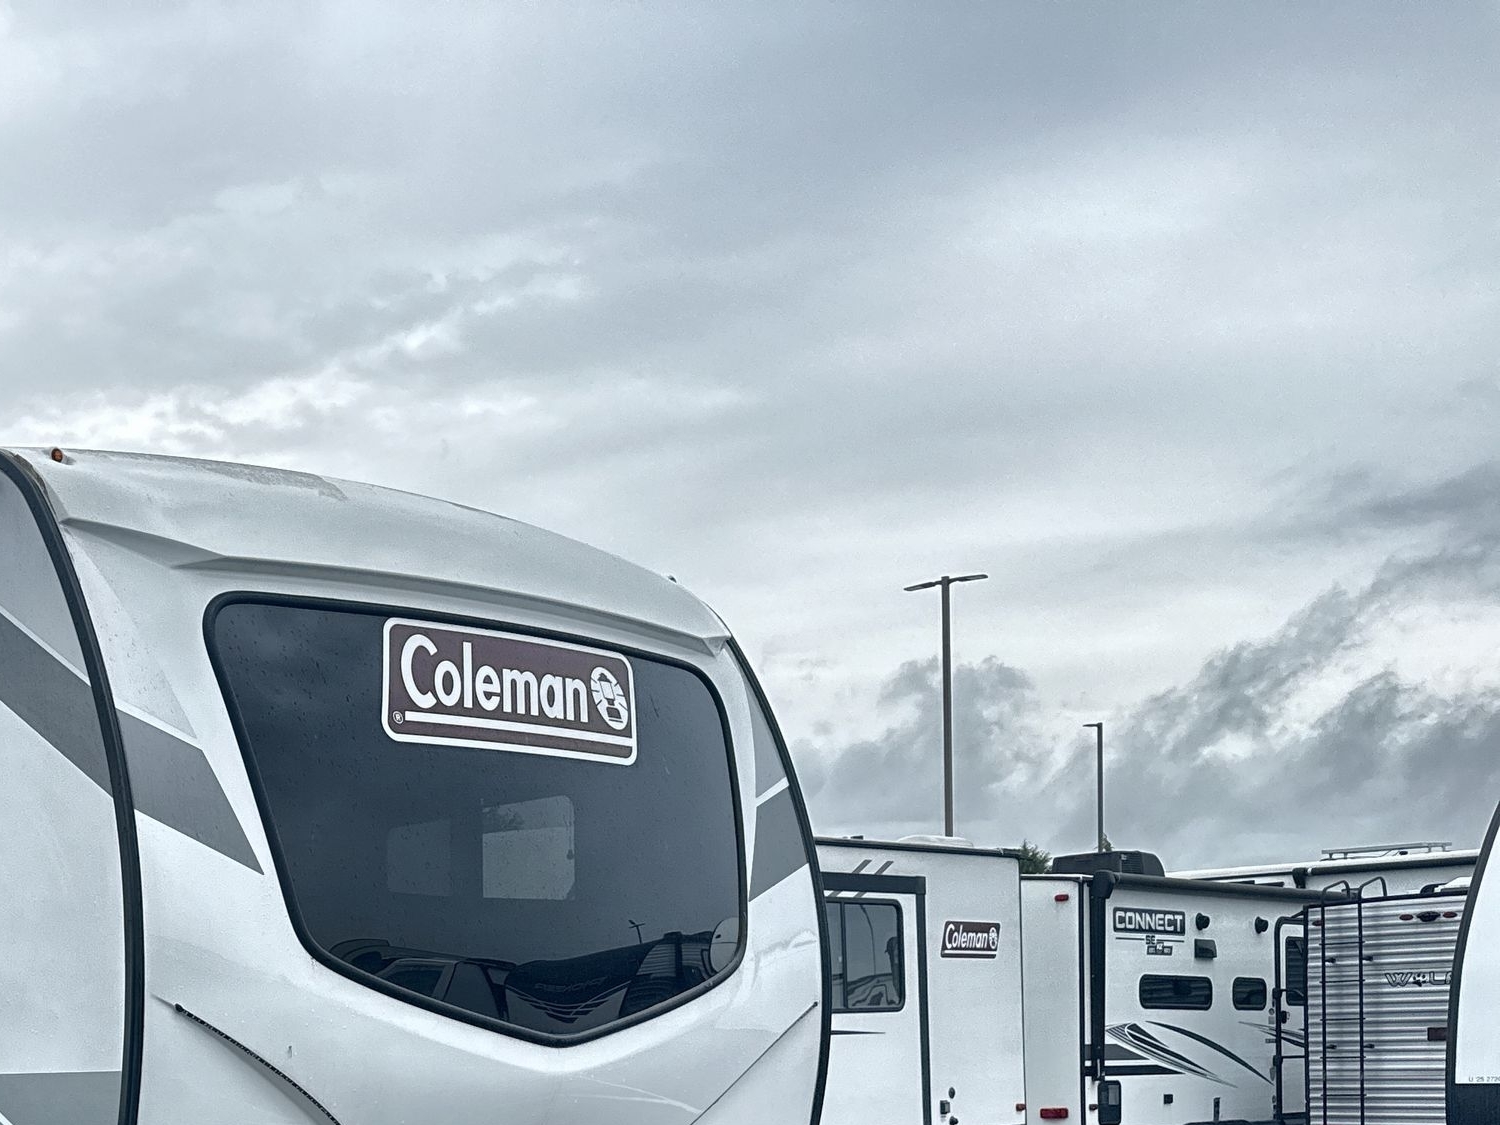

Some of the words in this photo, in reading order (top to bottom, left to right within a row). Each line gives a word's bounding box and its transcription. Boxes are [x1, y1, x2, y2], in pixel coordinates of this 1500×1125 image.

[400, 633, 589, 723] Coleman
[1115, 911, 1183, 932] CONNECT
[945, 924, 988, 949] Coleman
